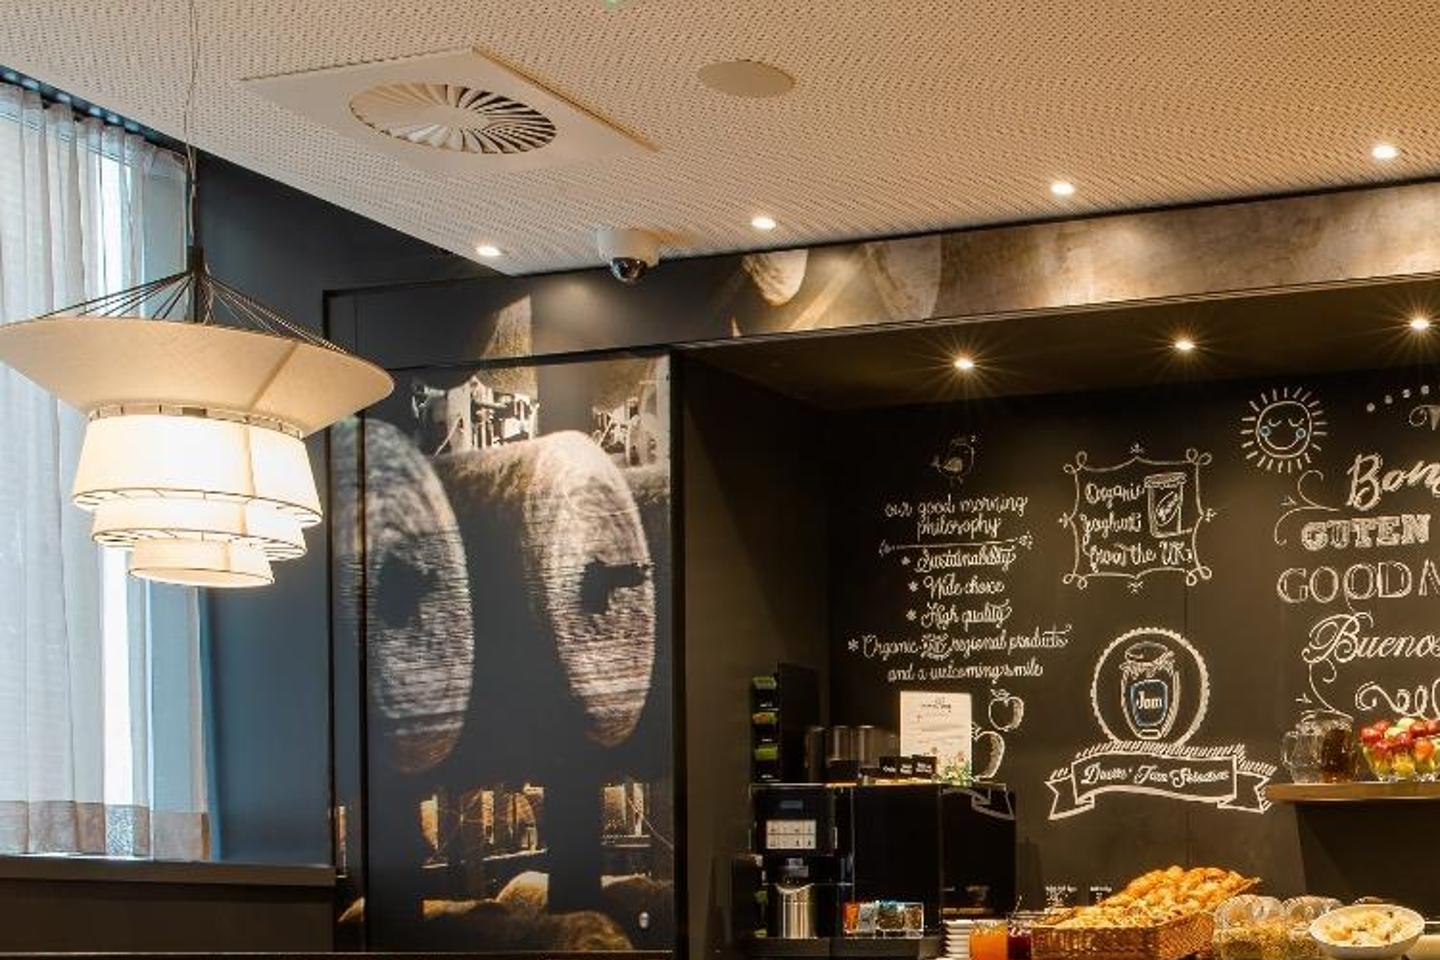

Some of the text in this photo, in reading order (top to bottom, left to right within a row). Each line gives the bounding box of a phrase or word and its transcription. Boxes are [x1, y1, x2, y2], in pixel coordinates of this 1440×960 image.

[885, 493, 1028, 521] our good morning
[1085, 482, 1145, 509] Organic
[1302, 514, 1431, 552] GUTEN
[923, 573, 963, 599] Wide
[1276, 562, 1412, 603] GOOD
[888, 663, 916, 682] and
[917, 667, 927, 680] a
[1003, 656, 1044, 678] smile
[1136, 690, 1163, 710] Jam
